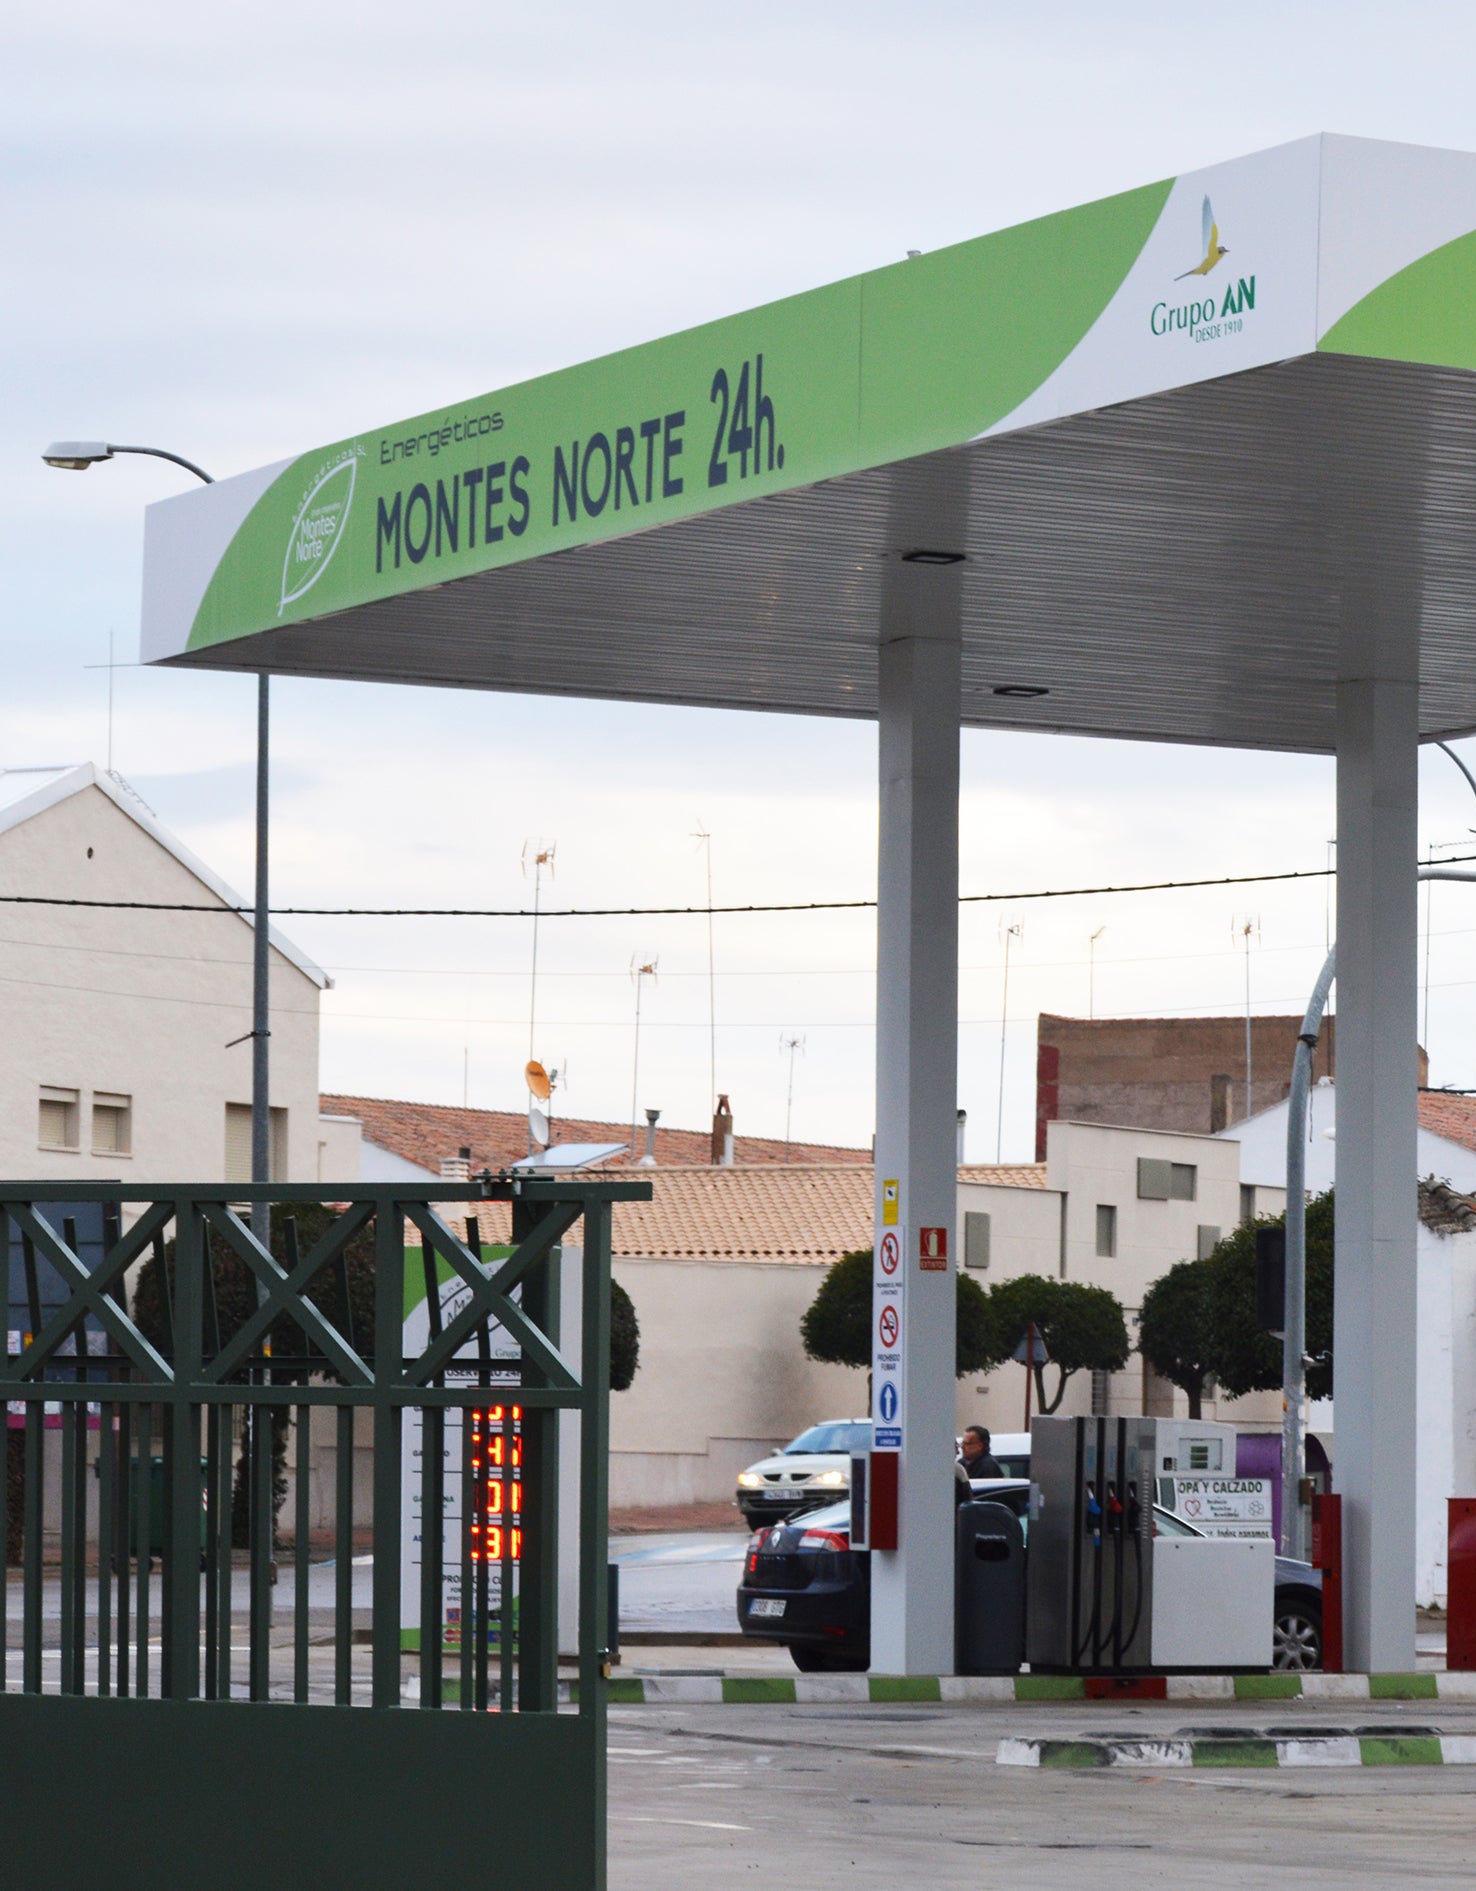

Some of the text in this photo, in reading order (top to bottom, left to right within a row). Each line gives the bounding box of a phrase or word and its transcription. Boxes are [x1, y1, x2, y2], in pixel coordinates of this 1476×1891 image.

[1151, 275, 1255, 337] Grupo AN
[1195, 318, 1243, 343] DESDE 1910
[379, 409, 505, 465] Energéticos
[375, 353, 785, 573] MONTES NORTE 24h.
[302, 515, 336, 540] Montes
[1179, 1482, 1262, 1493] OPA Y CALZADO
